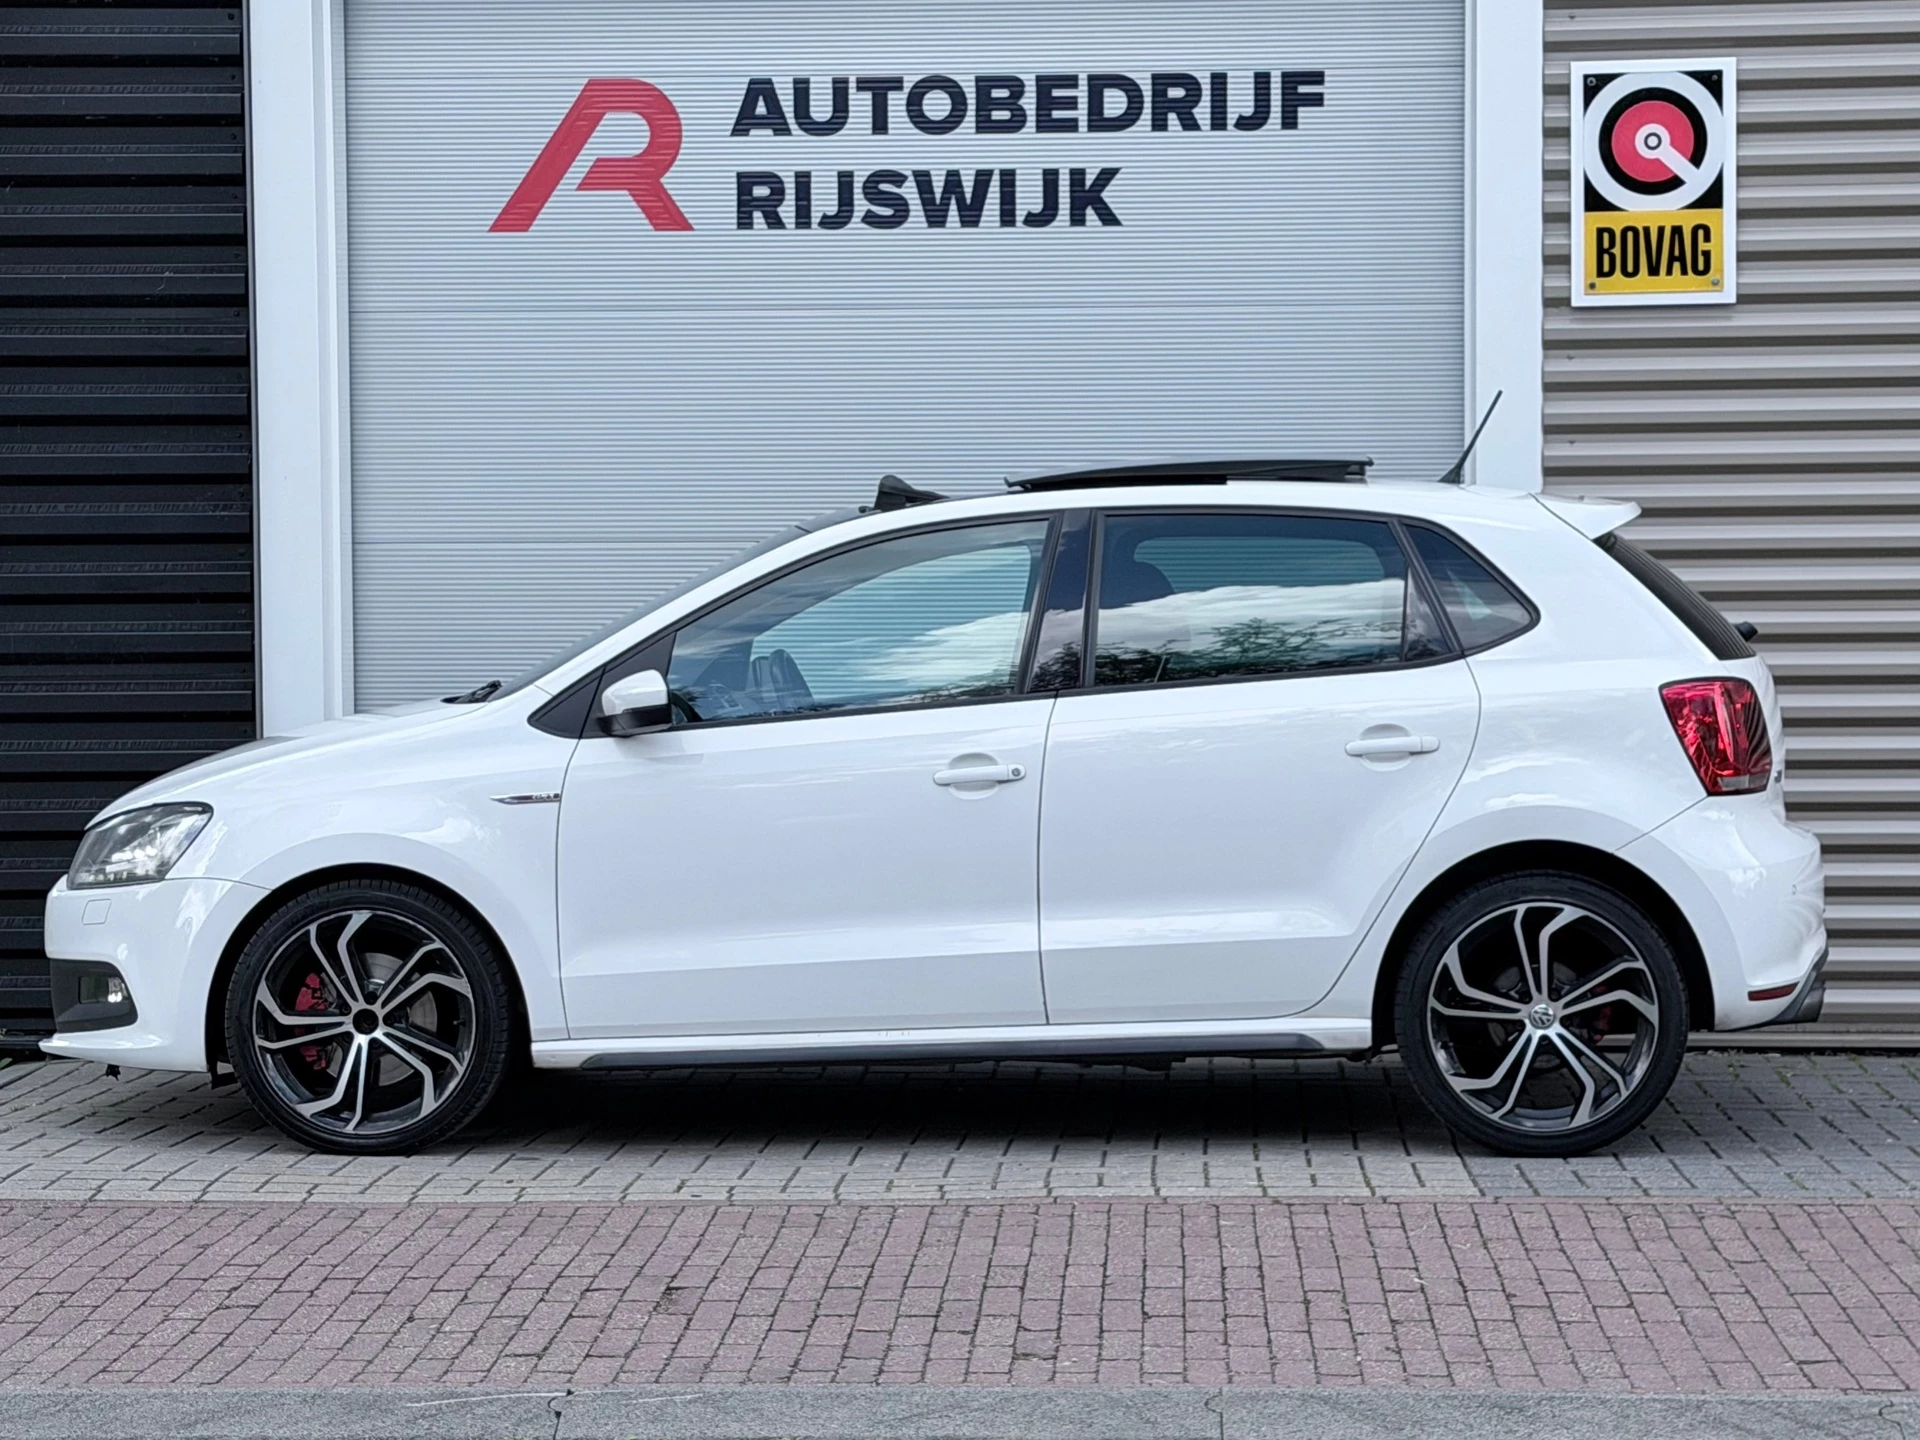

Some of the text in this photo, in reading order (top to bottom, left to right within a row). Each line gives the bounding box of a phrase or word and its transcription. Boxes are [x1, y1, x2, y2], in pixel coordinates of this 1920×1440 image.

[731, 70, 1326, 137] AUTOBEDRIJF
[735, 167, 1123, 231] RIJSWIJK
[1595, 223, 1712, 279] BOVAG
